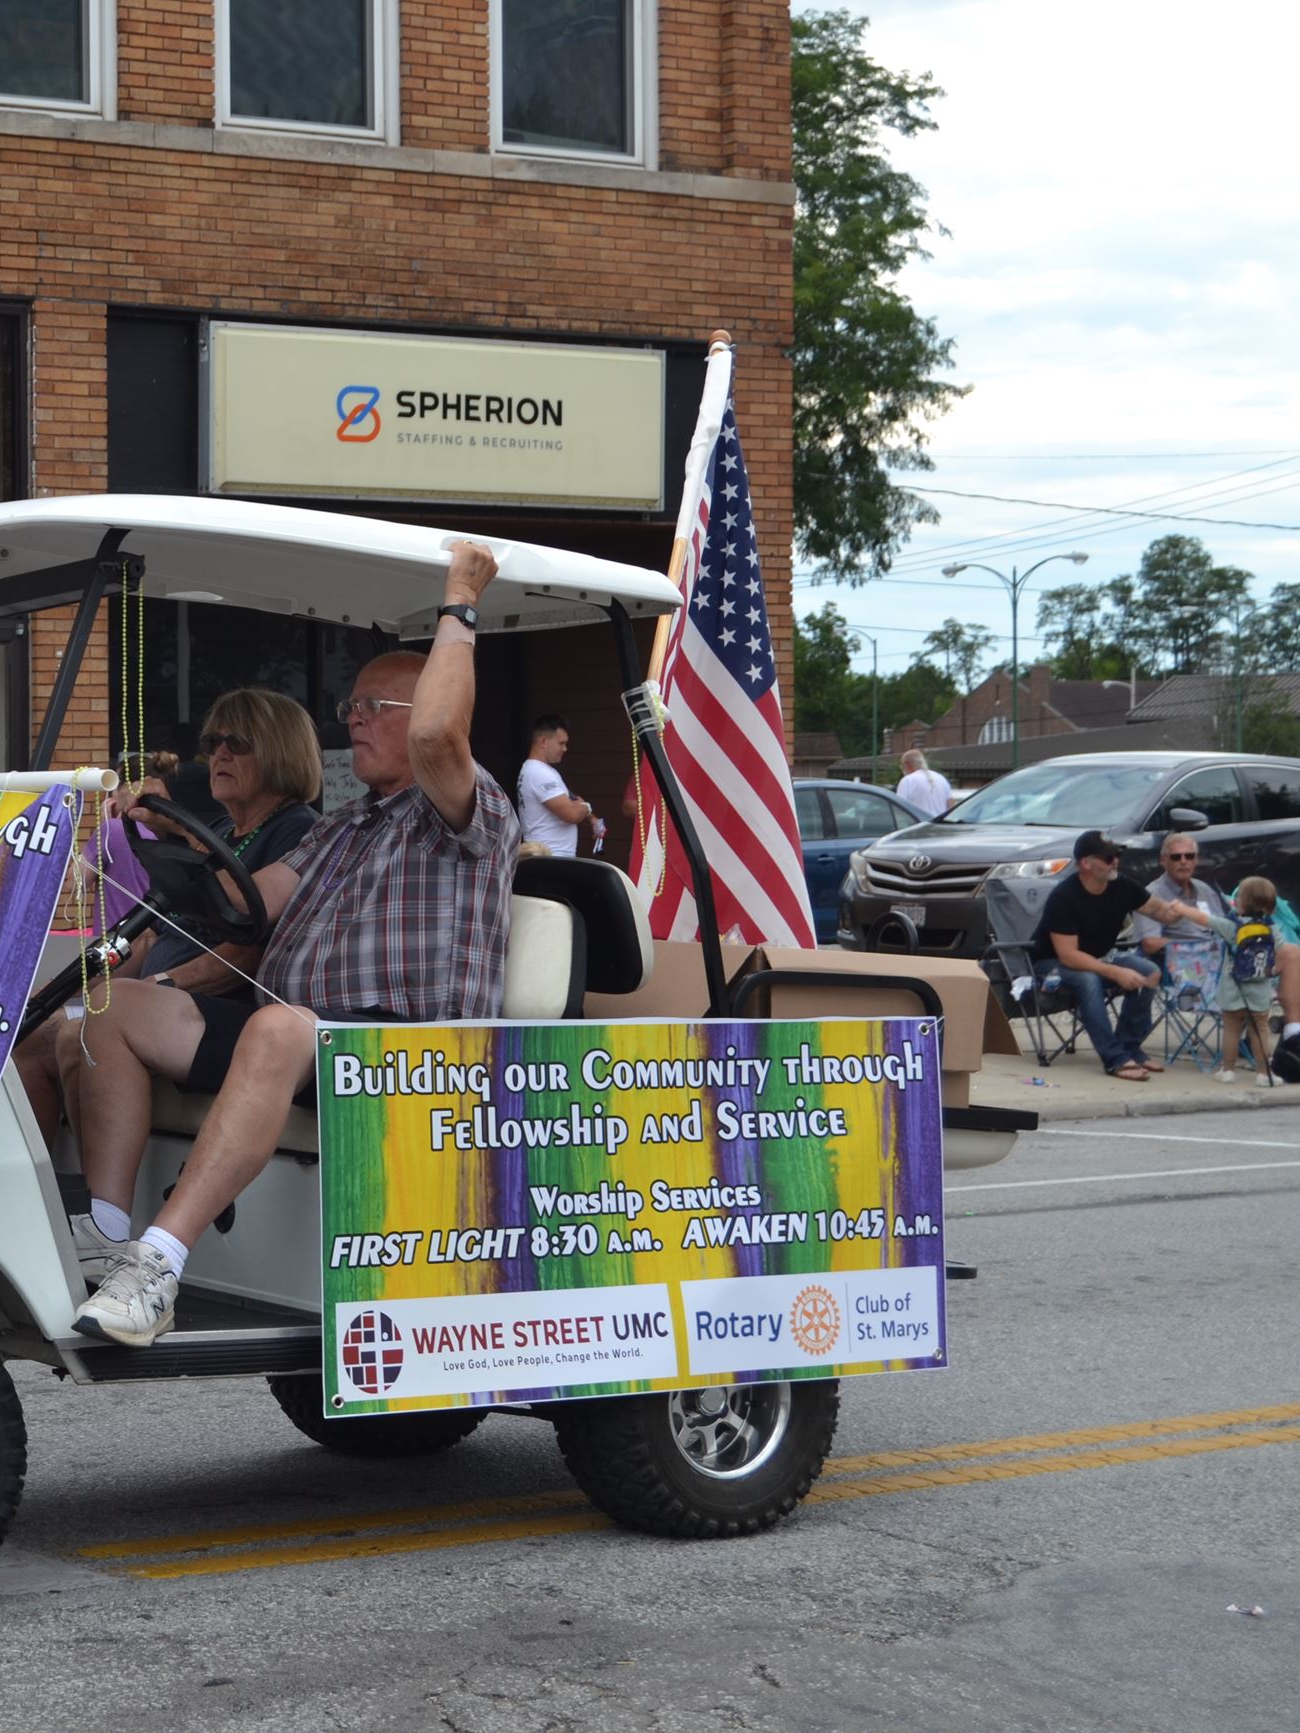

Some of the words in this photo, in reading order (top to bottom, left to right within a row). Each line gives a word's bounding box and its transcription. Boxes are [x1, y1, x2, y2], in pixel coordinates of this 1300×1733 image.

[396, 390, 563, 426] SPHERION
[396, 432, 463, 446] STAFFING
[469, 436, 477, 447] &
[482, 436, 563, 450] RECRUITING
[333, 1050, 491, 1102] Building
[581, 1045, 772, 1096] Community
[430, 1101, 628, 1155] Fellowship
[716, 1097, 847, 1141] Service
[529, 1180, 644, 1219] Worship
[650, 1176, 762, 1213] Services
[329, 1230, 423, 1268] FIRST
[427, 1227, 525, 1264] LIGHT
[530, 1222, 599, 1258] 8:30
[681, 1212, 809, 1249] AWAKEN
[814, 1208, 885, 1242] 10:45
[855, 1294, 890, 1315] Club
[894, 1292, 912, 1313] of
[411, 1321, 505, 1355] WAYNE
[513, 1315, 604, 1348] STREET
[612, 1311, 669, 1341] UMC
[695, 1310, 783, 1342] Rotary
[857, 1321, 877, 1341] St.
[881, 1320, 929, 1342] Marys
[443, 1360, 465, 1371] Love
[468, 1358, 490, 1370] God,
[492, 1357, 514, 1368] Love
[517, 1354, 553, 1367] People,
[555, 1352, 591, 1364] Change
[594, 1351, 610, 1361] the
[611, 1347, 643, 1359] World.
